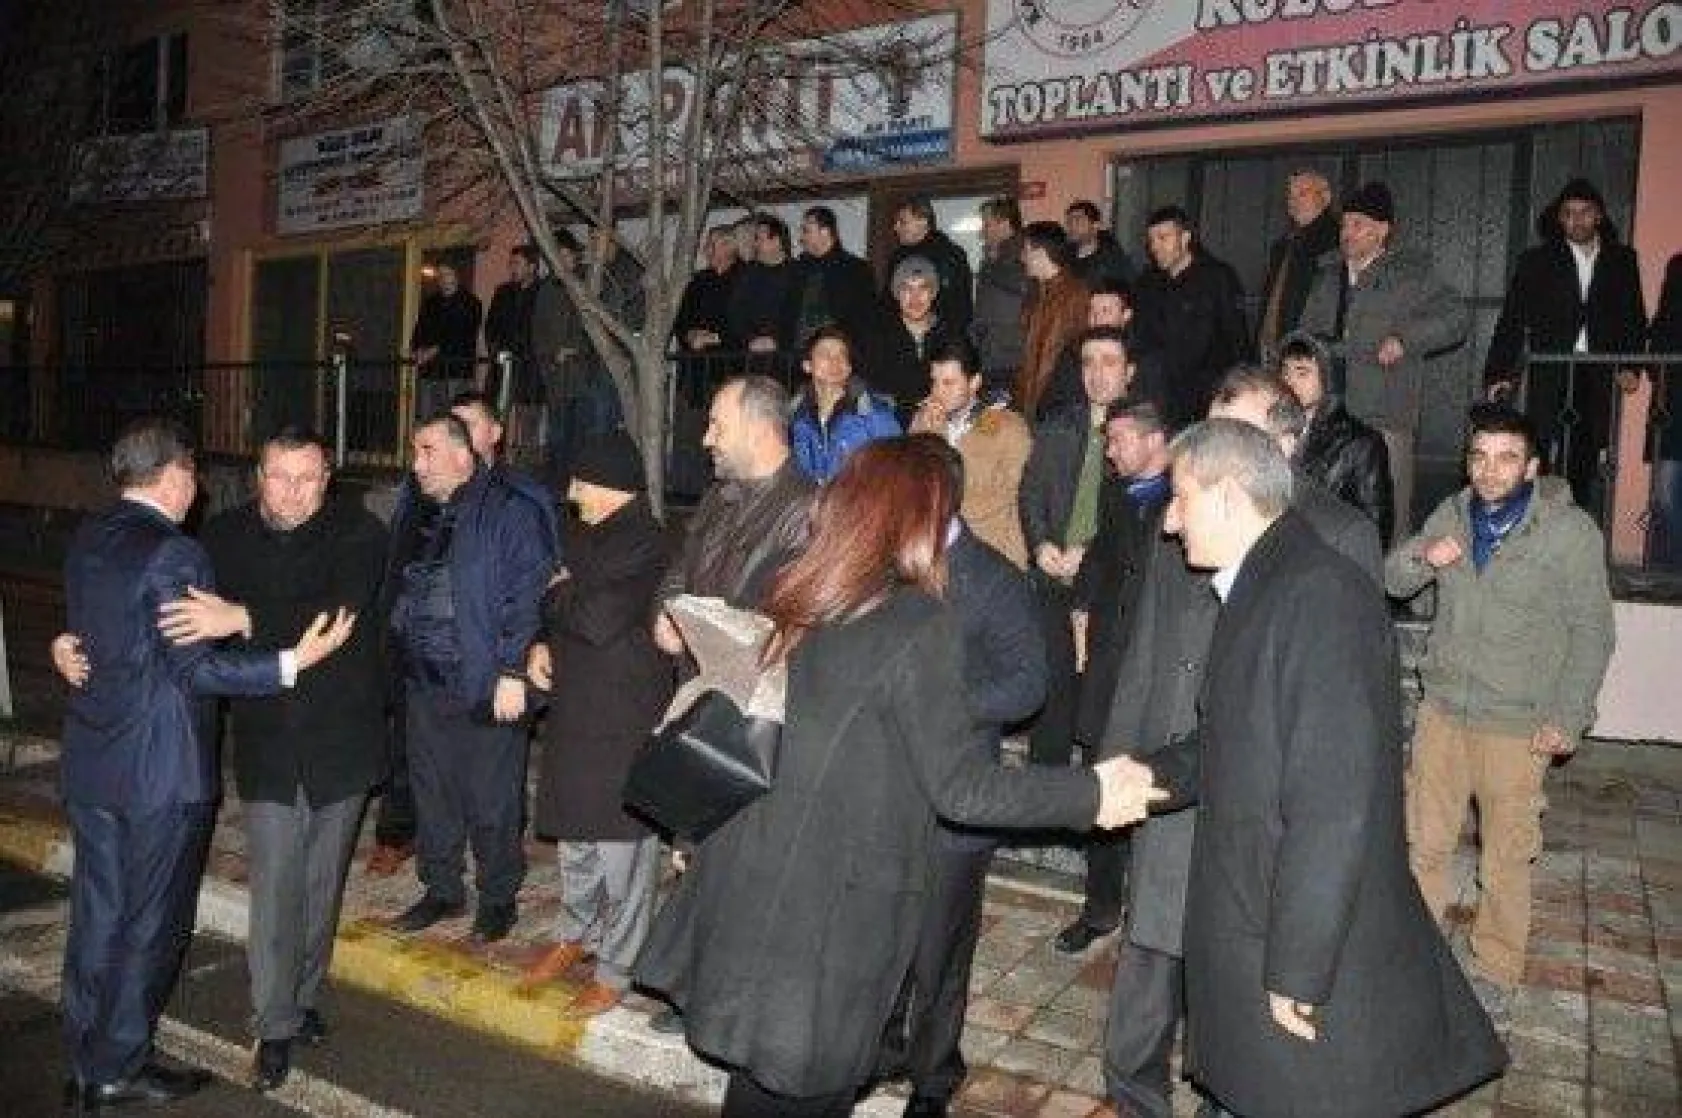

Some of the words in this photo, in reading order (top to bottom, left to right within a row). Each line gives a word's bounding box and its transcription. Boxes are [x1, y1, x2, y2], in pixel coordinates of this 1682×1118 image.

[991, 65, 1193, 125] TOPLANTI
[1206, 68, 1253, 102] ve
[1265, 17, 1511, 96] ETKİNLİK
[1526, 4, 1682, 71] SALO
